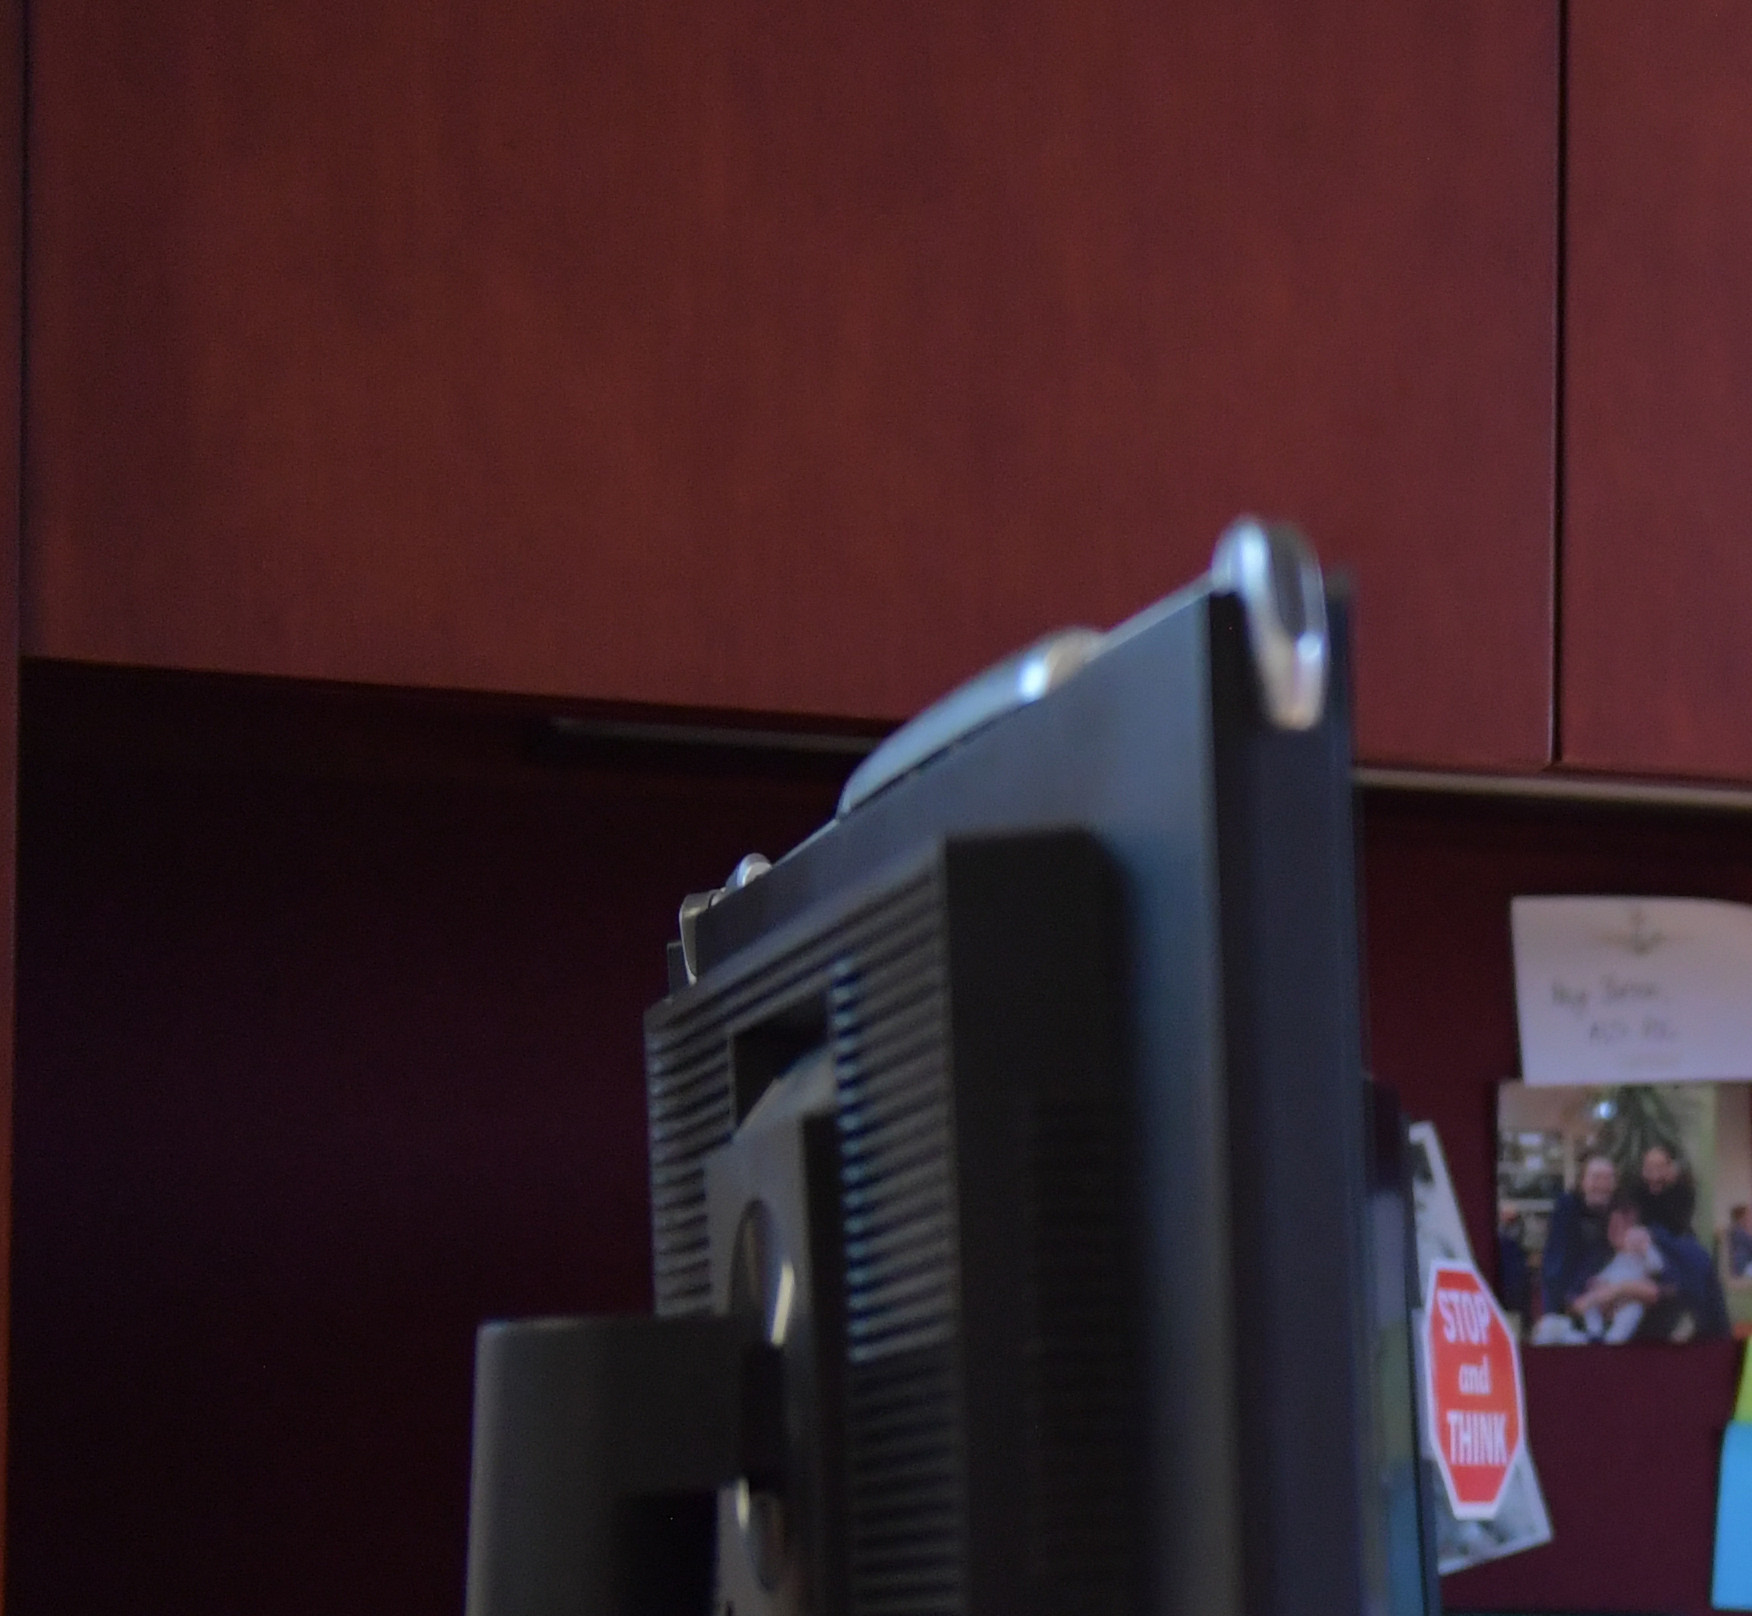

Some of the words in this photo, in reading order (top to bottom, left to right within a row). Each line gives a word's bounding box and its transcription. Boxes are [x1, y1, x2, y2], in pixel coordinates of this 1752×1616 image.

[1437, 1289, 1491, 1344] STOP
[1458, 1353, 1492, 1395] and
[1447, 1410, 1507, 1465] THINK
